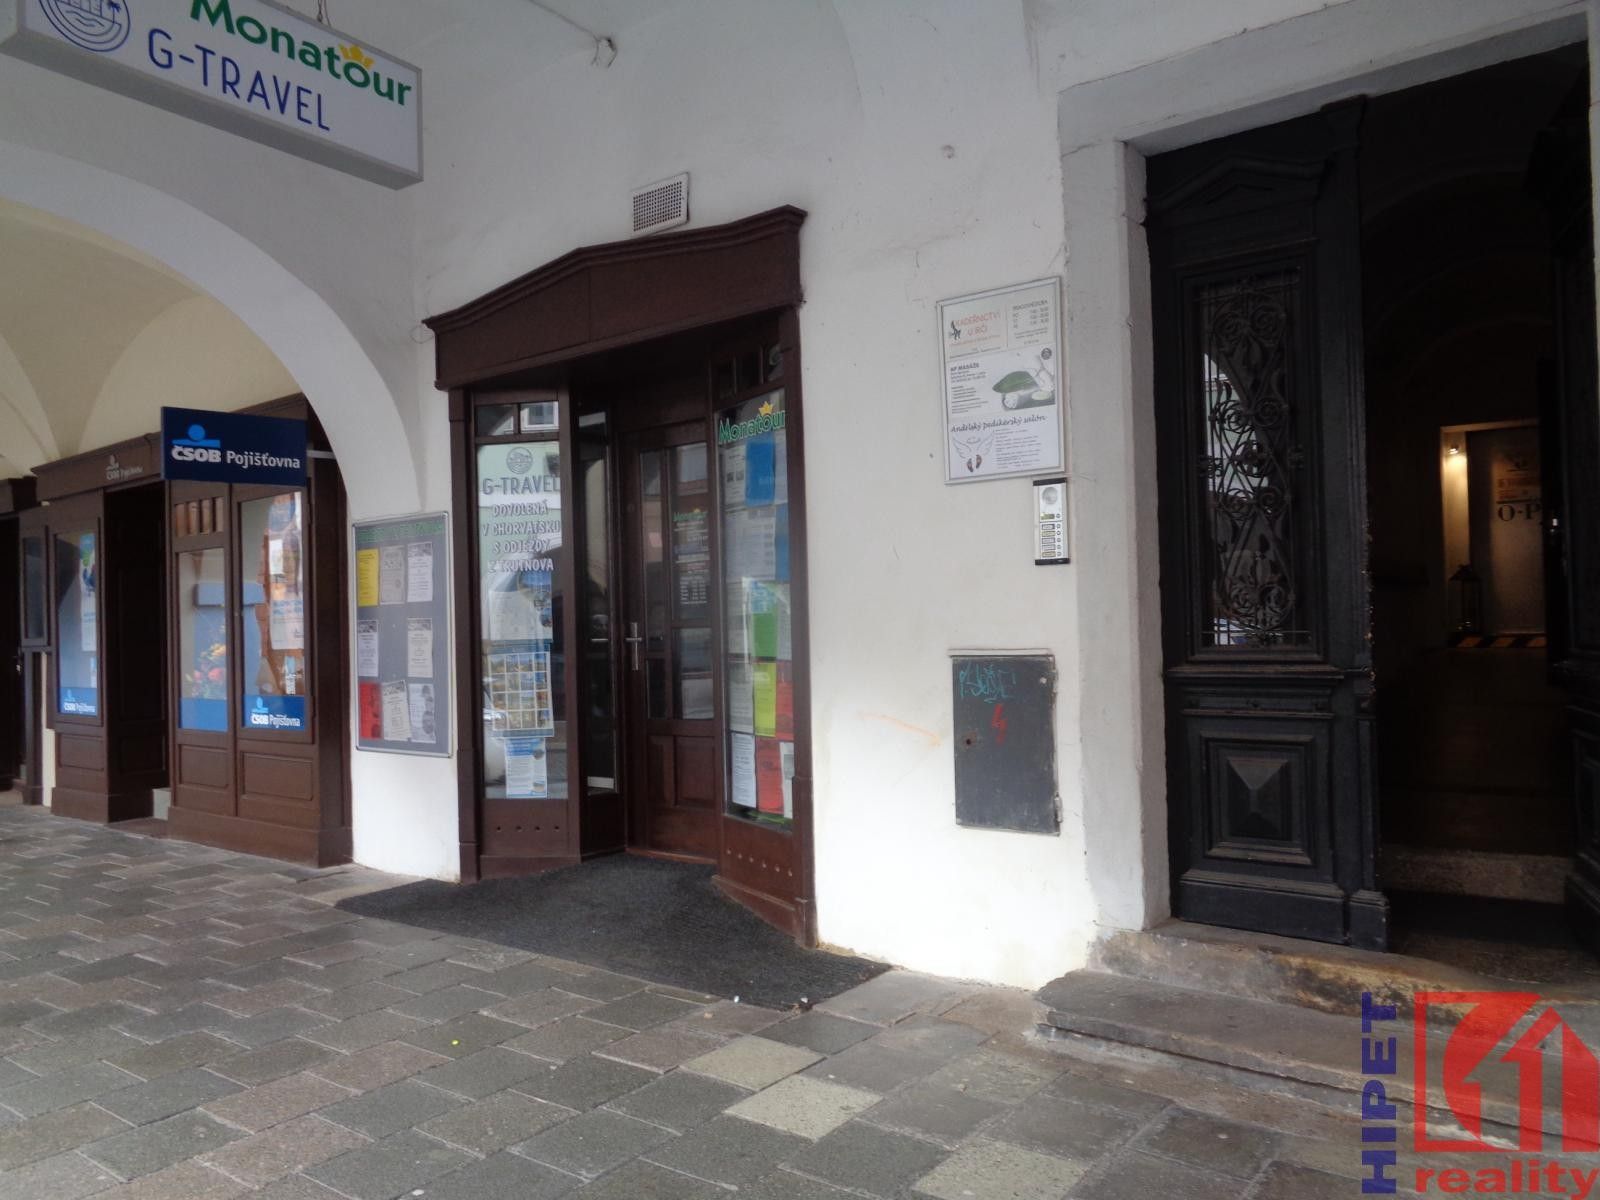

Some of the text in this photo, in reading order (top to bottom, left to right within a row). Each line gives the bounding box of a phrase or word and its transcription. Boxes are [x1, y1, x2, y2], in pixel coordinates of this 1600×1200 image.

[190, 0, 412, 106] Monatour
[148, 28, 331, 132] G-TRAVEL
[718, 410, 786, 444] Monatour
[171, 445, 301, 469] ČSOB Pojišťovna
[482, 475, 561, 495] G-TRAVEL
[492, 499, 549, 518] DOVOLENÁ
[493, 519, 561, 537] CHORVATSKU
[493, 538, 551, 554] S ODJEZDY
[498, 557, 554, 574] TRUTNOVA
